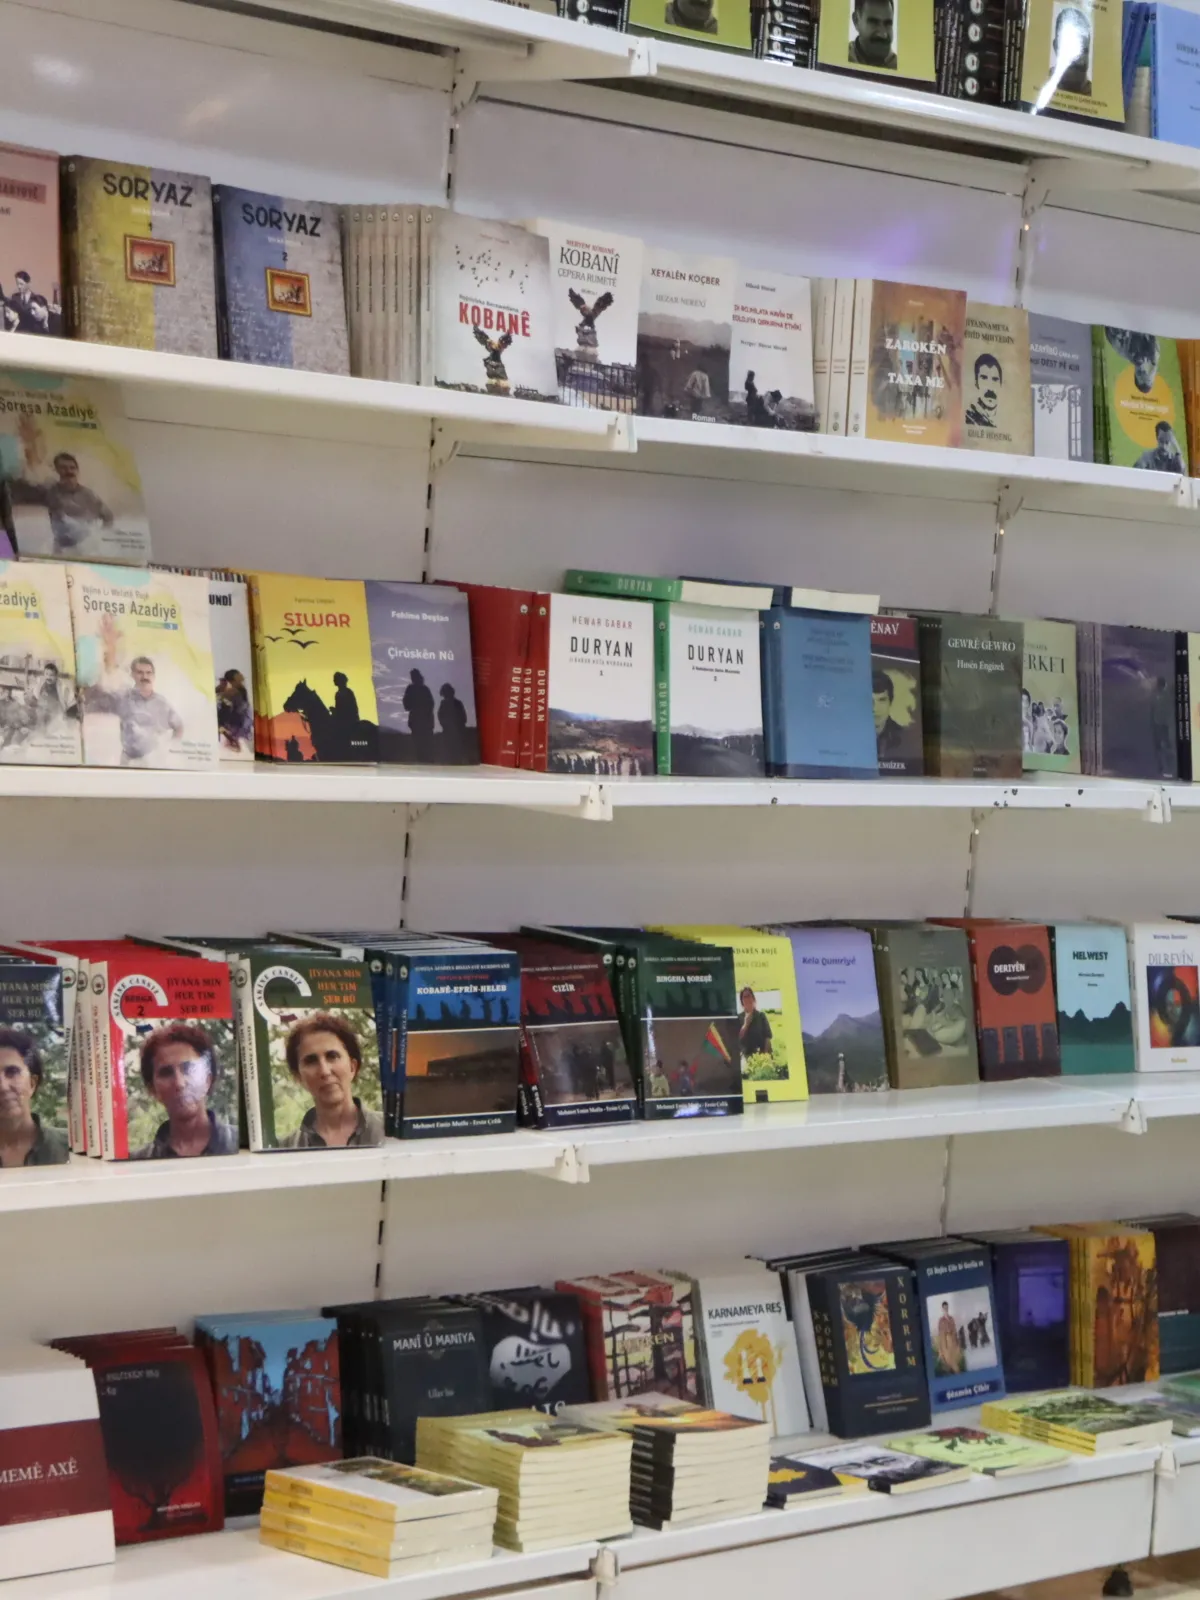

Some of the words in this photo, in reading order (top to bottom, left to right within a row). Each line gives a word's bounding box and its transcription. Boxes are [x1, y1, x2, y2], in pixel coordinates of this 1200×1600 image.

[103, 172, 193, 208] SORYAZ
[243, 203, 321, 238] SORYAZ
[560, 246, 620, 275] KOBANÎ
[650, 267, 686, 282] XEYALÊN
[688, 273, 721, 287] KOÇBER
[459, 301, 531, 337] KOBANÊ
[885, 338, 947, 356] ZAROKÊN
[887, 372, 923, 388] TAXA
[691, 413, 716, 424] Roman
[617, 577, 653, 592] DURYAN
[83, 595, 126, 616] Şoreşa
[130, 600, 177, 621] Azadiyê
[284, 612, 351, 629] SIWAR
[572, 615, 603, 627] HEWAR
[605, 618, 633, 630] GABAR
[388, 647, 436, 661] Çirûskên
[439, 649, 455, 662] Nû
[570, 636, 633, 658] DURYAN
[688, 644, 744, 665] DURYAN
[981, 640, 1016, 652] GEWRO
[508, 667, 522, 720] DURYAN
[522, 668, 532, 721] DURYAN
[536, 669, 546, 722] DURYAN
[659, 682, 667, 733] DURYAN
[1072, 951, 1109, 961] HELWEST
[309, 968, 343, 981] JIYANA
[993, 961, 1026, 974] DERIYÊN
[202, 977, 222, 987] MIN
[317, 982, 336, 991] HER
[340, 982, 358, 992] TIM
[416, 984, 507, 995] KOBANÊ-EFRÎN-HELEB
[174, 991, 195, 1001] HER
[199, 991, 216, 1000] TIM
[323, 995, 341, 1005] ŞER
[345, 994, 357, 1004] BÛ
[136, 1006, 145, 1017] 2
[179, 1005, 197, 1015] ŞER
[199, 1004, 214, 1014] BÛ
[708, 1304, 765, 1320] KARNAMEYA
[765, 1301, 782, 1316] REŞ
[392, 1335, 421, 1351] MANÎ
[424, 1332, 433, 1348] Û
[47, 1456, 79, 1478] AXÊ
